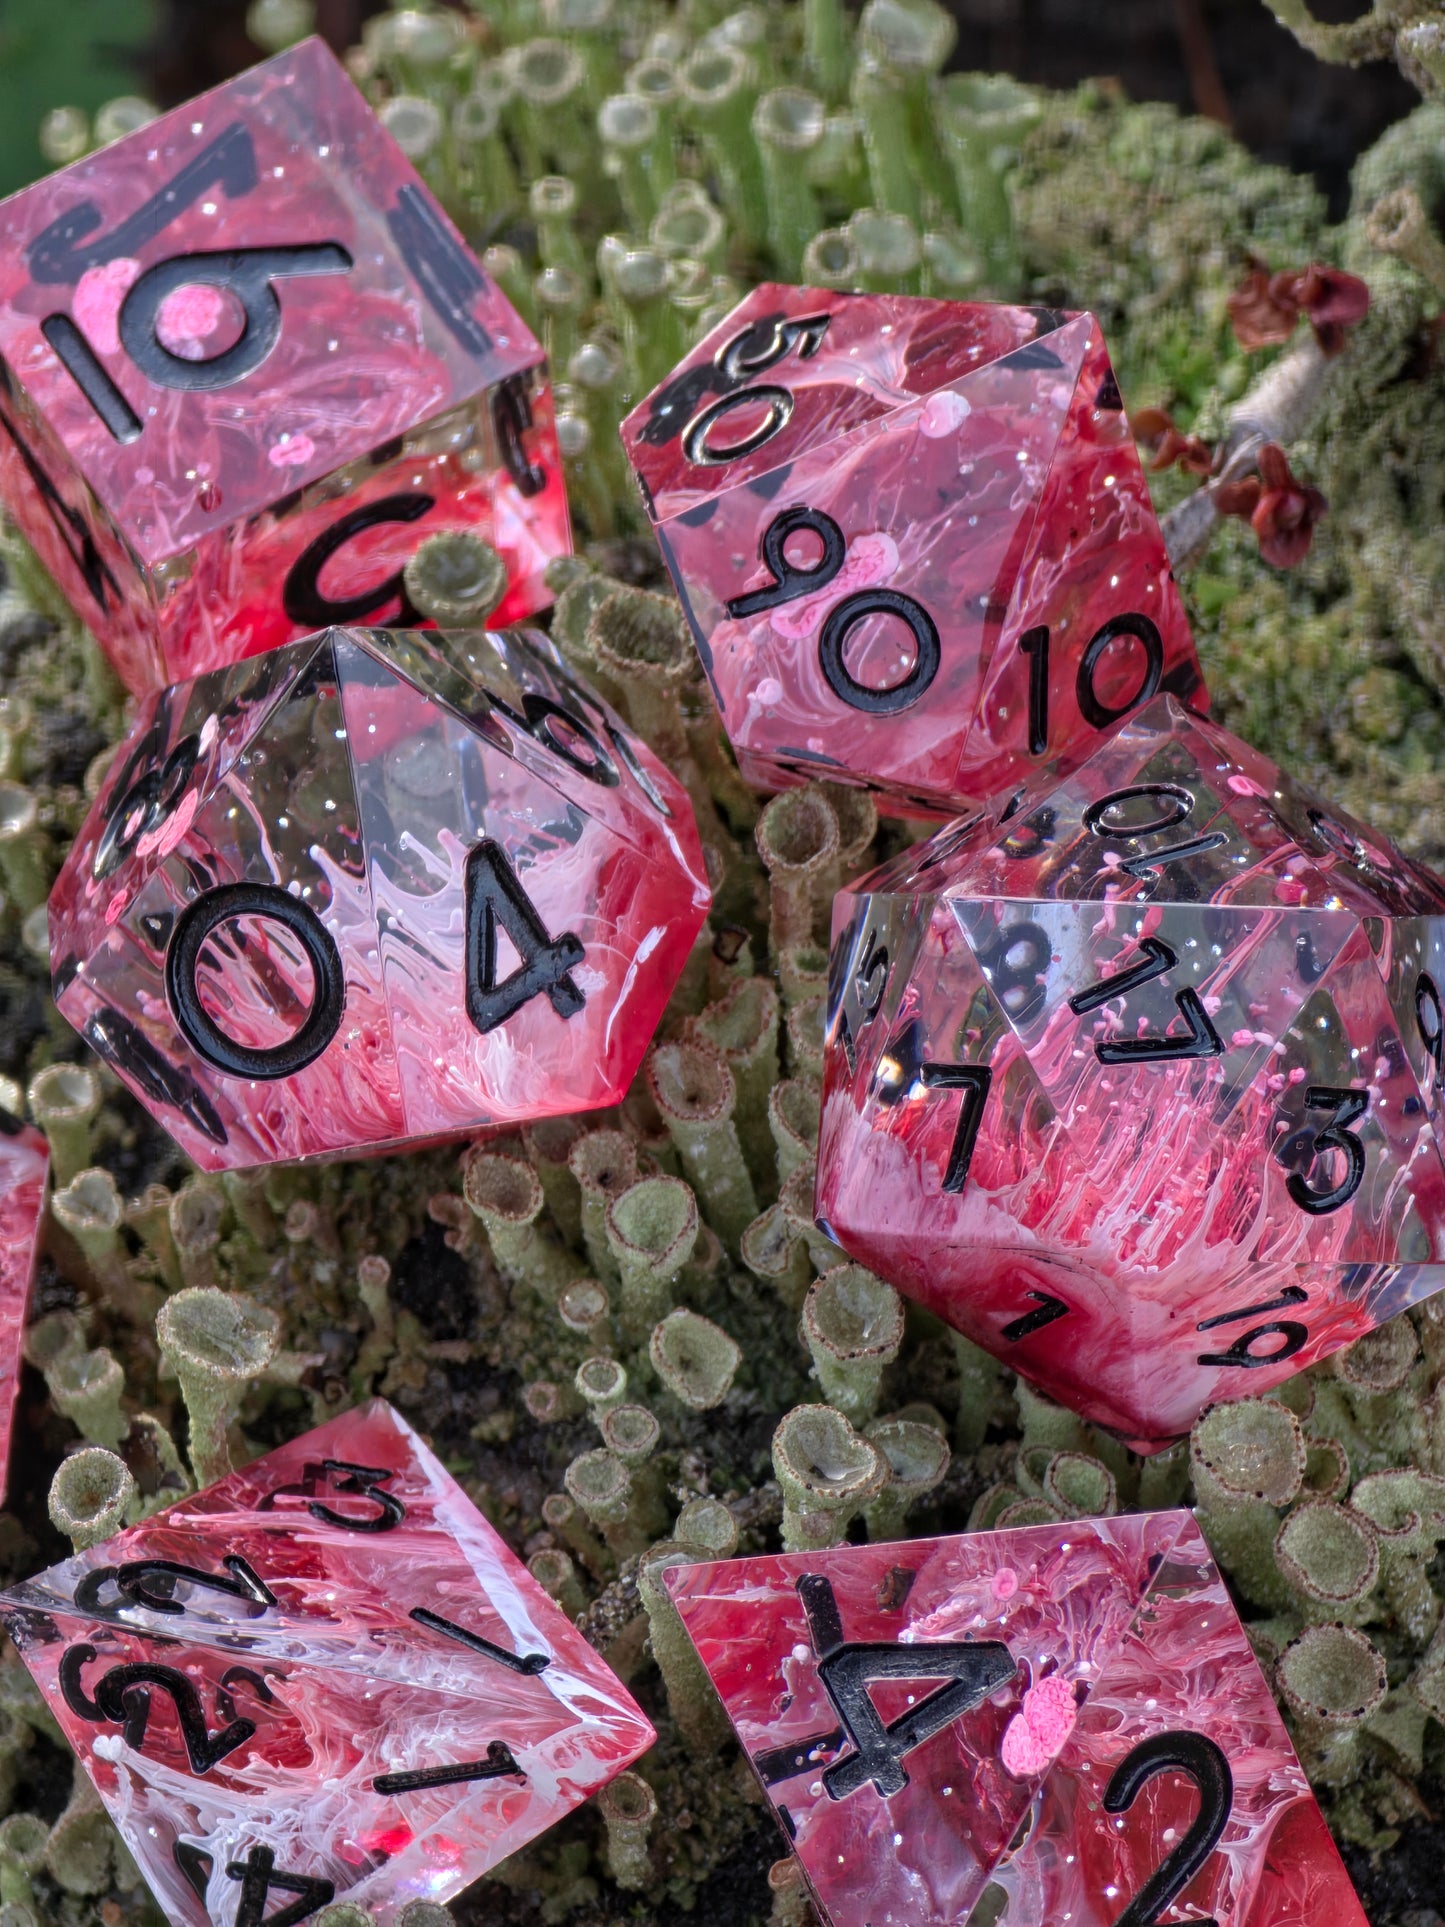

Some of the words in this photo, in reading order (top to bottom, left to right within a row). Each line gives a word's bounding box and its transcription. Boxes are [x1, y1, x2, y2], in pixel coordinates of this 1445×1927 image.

[1017, 612, 1166, 758] 10
[164, 881, 347, 1081] 0
[464, 838, 586, 1034] 4
[1069, 937, 1226, 1067] 17
[920, 1062, 993, 1194] 7
[1284, 1086, 1371, 1216] 3
[307, 1458, 406, 1533] 3
[94, 1662, 257, 1775] 2
[372, 1740, 527, 1797] 1
[817, 1640, 1018, 1801] 4
[1102, 1730, 1234, 1927] 2
